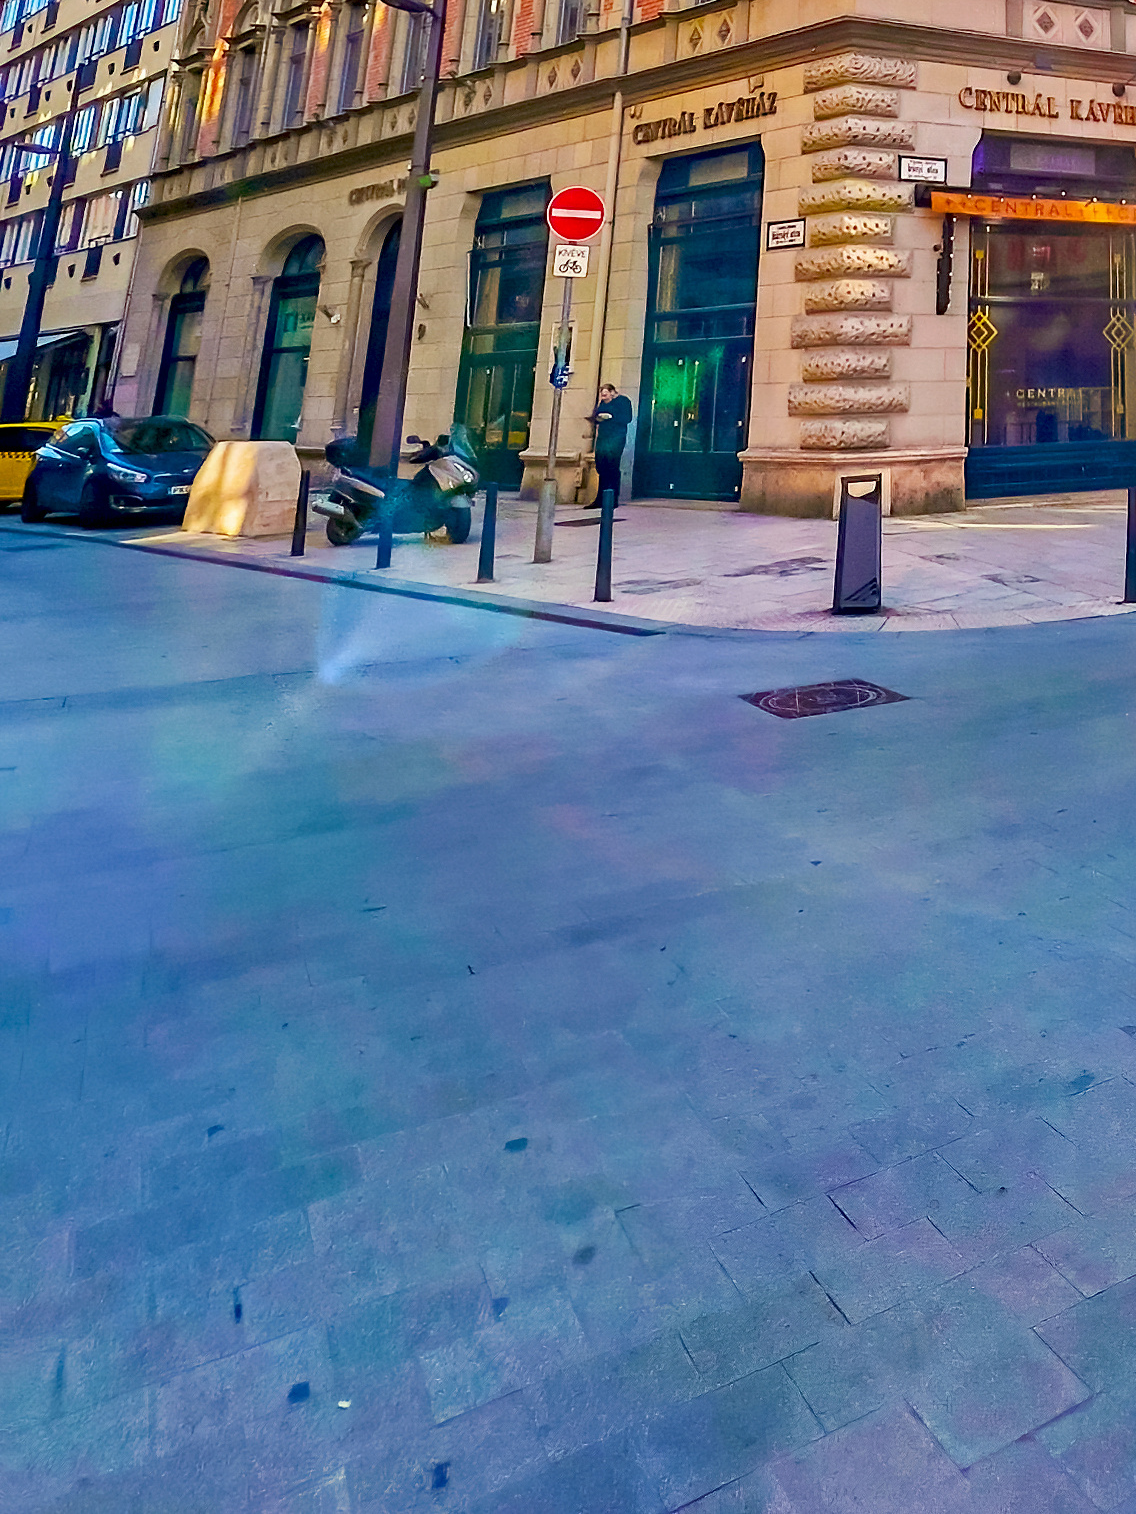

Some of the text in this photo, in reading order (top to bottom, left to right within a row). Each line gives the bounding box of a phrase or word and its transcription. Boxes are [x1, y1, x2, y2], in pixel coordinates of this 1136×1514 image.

[958, 86, 1059, 119] CENTRÁL
[633, 91, 778, 145] CENTRÁL KÁVÉHÁZ
[974, 199, 1073, 217] CENTRAL
[558, 249, 586, 258] KIVÉVE
